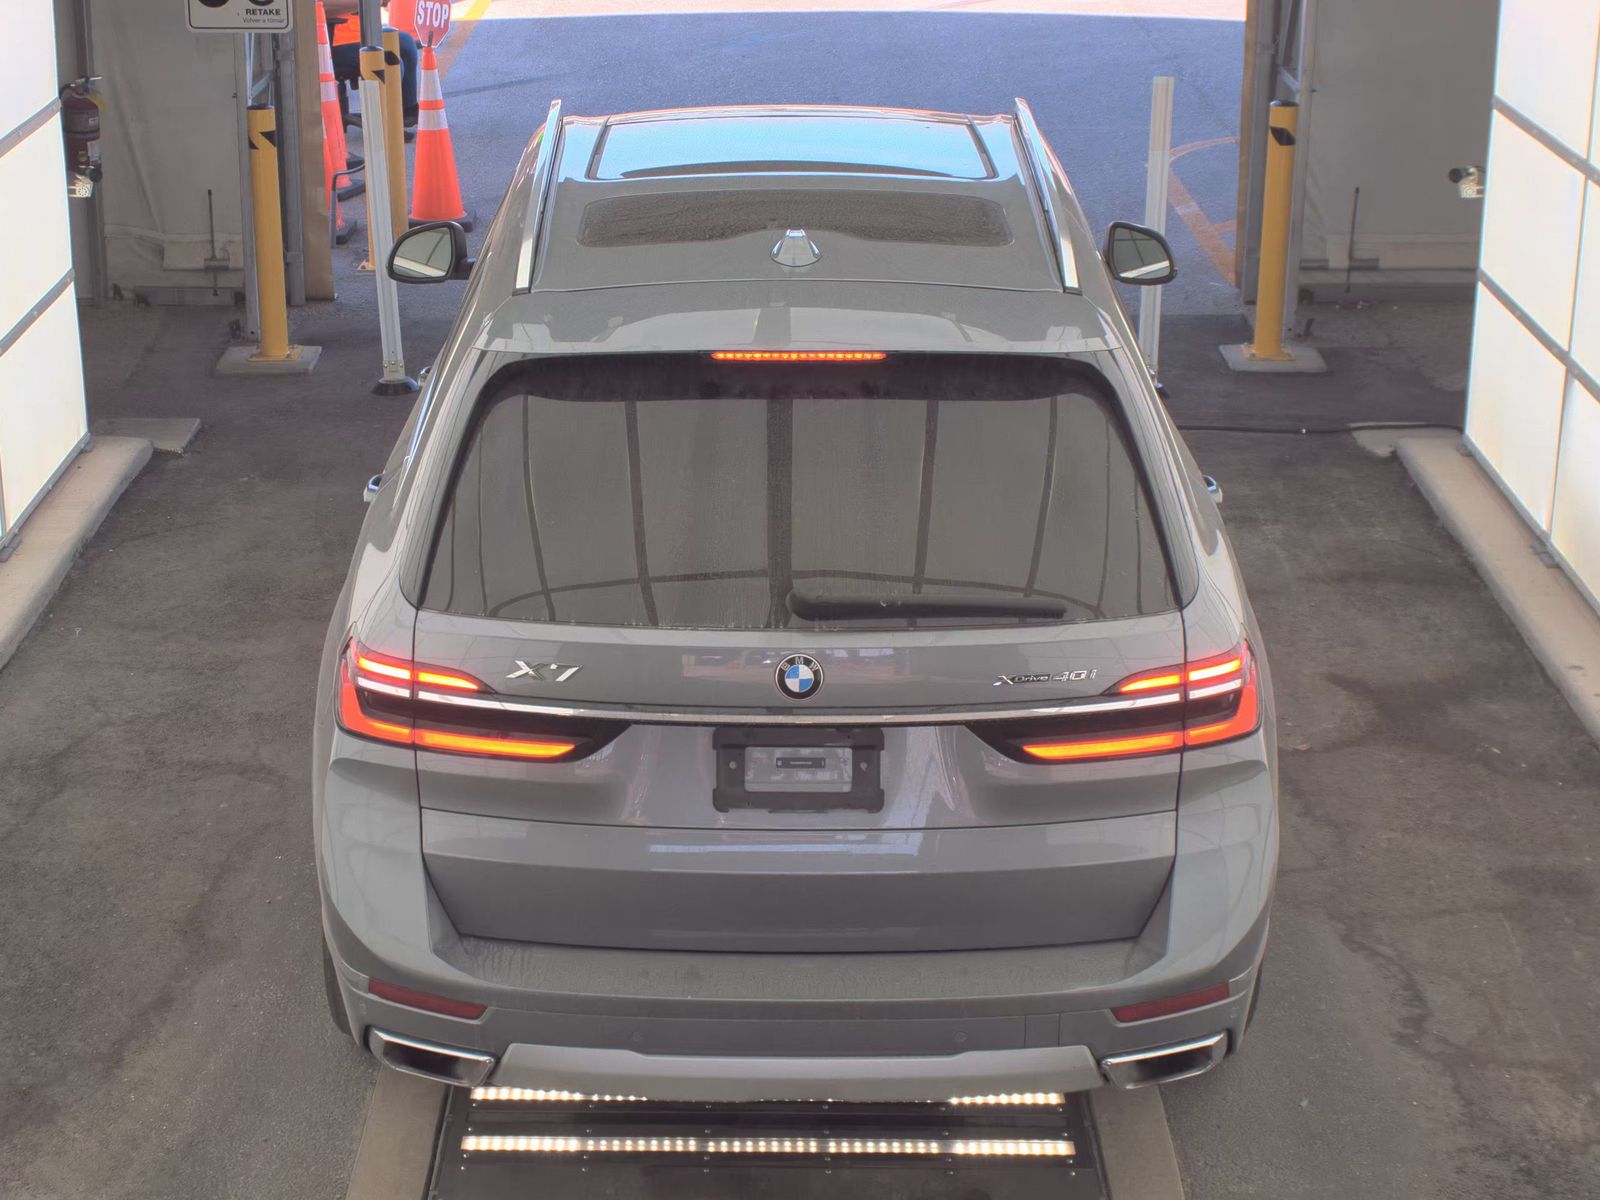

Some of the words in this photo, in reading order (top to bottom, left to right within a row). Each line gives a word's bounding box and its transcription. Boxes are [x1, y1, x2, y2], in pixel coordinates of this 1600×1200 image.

[245, 8, 281, 16] RETAKE
[417, 0, 449, 28] STOP
[505, 660, 583, 682] X7
[780, 656, 819, 671] BMW
